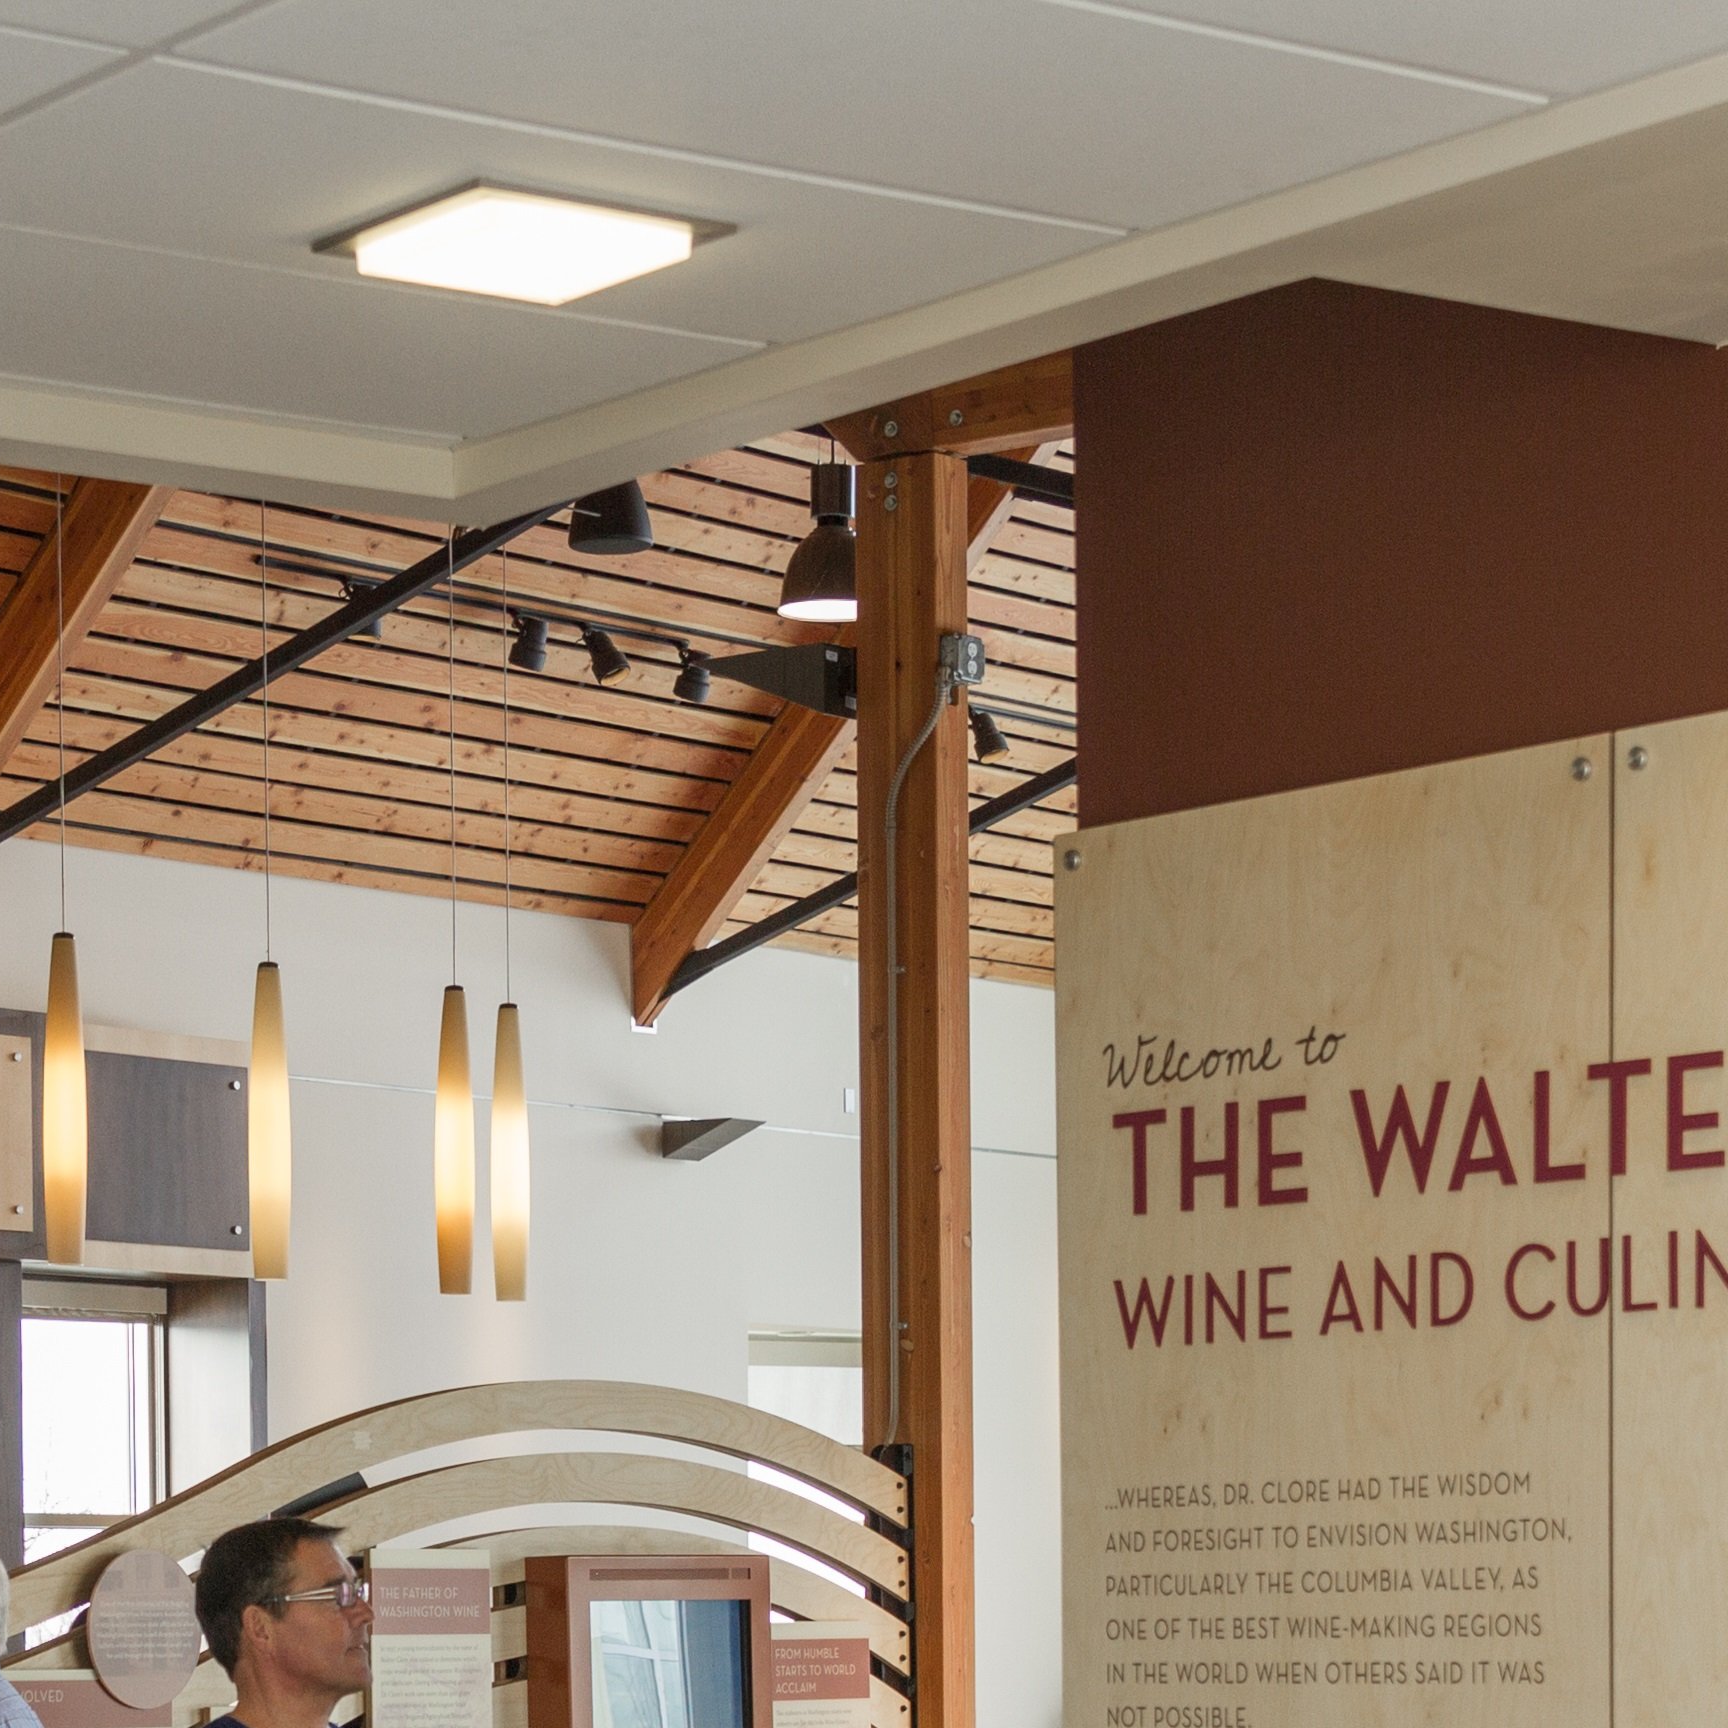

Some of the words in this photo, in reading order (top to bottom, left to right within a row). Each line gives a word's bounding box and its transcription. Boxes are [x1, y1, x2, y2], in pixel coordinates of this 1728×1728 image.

[1101, 1034, 1283, 1090] Welcome
[1294, 1024, 1347, 1067] to
[1112, 1095, 1309, 1216] THE
[1113, 1265, 1293, 1350] WINE
[1319, 1251, 1474, 1336] AND
[1223, 1481, 1255, 1506] DR.
[1260, 1478, 1331, 1505] CLORE
[1337, 1476, 1382, 1502] HAD
[1388, 1473, 1430, 1500] THE
[1436, 1470, 1531, 1497] WISDOM
[1104, 1530, 1147, 1554] AND
[1152, 1526, 1265, 1553] FORESIGHT
[1271, 1524, 1300, 1550] TO
[1306, 1522, 1408, 1549] ENVISION
[1414, 1517, 1573, 1545] WASHINGTON,
[379, 1586, 400, 1599] THE
[402, 1586, 441, 1599] FATHER
[443, 1586, 459, 1599] OF
[1105, 1572, 1249, 1597] PARTICULARLY
[1254, 1570, 1295, 1595] THE
[1300, 1568, 1414, 1594] COLUMBIA
[1420, 1566, 1505, 1593] VALLEY,
[1511, 1564, 1540, 1590] AS
[379, 1605, 452, 1618] WASHINGTON
[453, 1605, 481, 1618] WINE
[1105, 1617, 1148, 1641] ONE
[1153, 1617, 1182, 1641] OF
[1186, 1616, 1226, 1641] THE
[1232, 1615, 1281, 1640] BEST
[1286, 1613, 1436, 1639] WINE-MAKING
[1443, 1612, 1543, 1638] REGIONS
[774, 1648, 802, 1661] FROM
[803, 1647, 840, 1660] HUMBLE
[775, 1665, 808, 1678] STARTS
[809, 1664, 822, 1677] TO
[823, 1663, 857, 1676] WORLD
[1106, 1662, 1126, 1685] IN
[1131, 1661, 1169, 1685] THE
[1174, 1661, 1249, 1685] WORLD
[1255, 1661, 1318, 1685] WHEN
[1324, 1660, 1408, 1686] OTHERS
[1414, 1660, 1464, 1685] SAID
[1471, 1660, 1491, 1685] IT
[1496, 1660, 1545, 1685] WAS
[22, 1688, 64, 1703] OLVED
[775, 1681, 817, 1695] ACCLAIM
[1106, 1705, 1148, 1728] NOT
